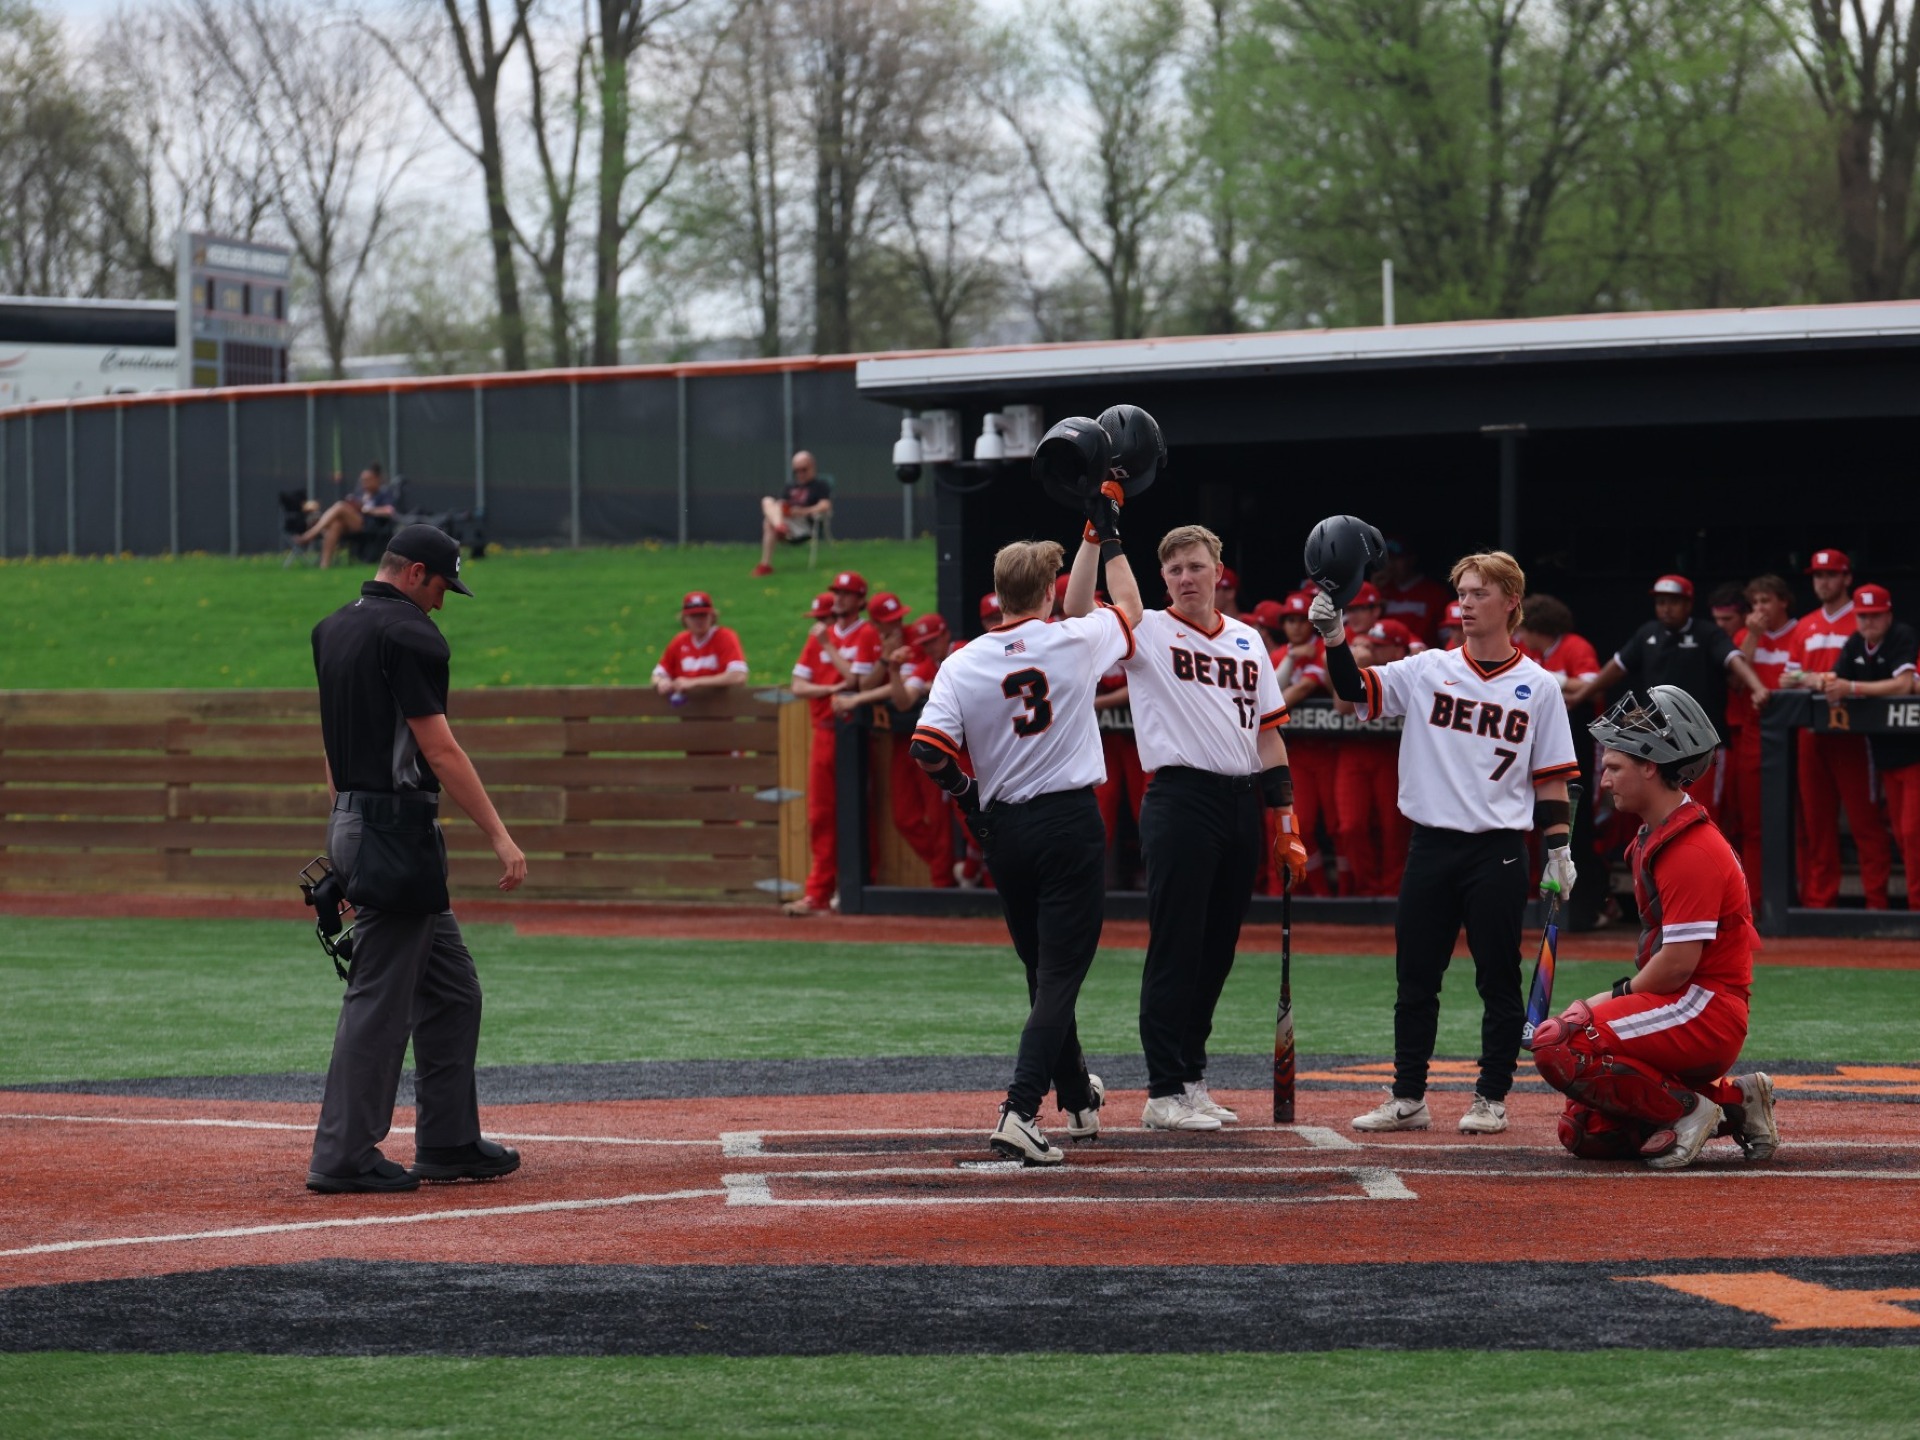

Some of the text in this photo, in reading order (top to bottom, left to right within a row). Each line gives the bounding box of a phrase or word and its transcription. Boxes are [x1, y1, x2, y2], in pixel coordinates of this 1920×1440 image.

[1169, 645, 1259, 691] BERG
[1000, 666, 1053, 738] 3
[1429, 690, 1530, 744] BERG
[1488, 747, 1518, 781] 7
